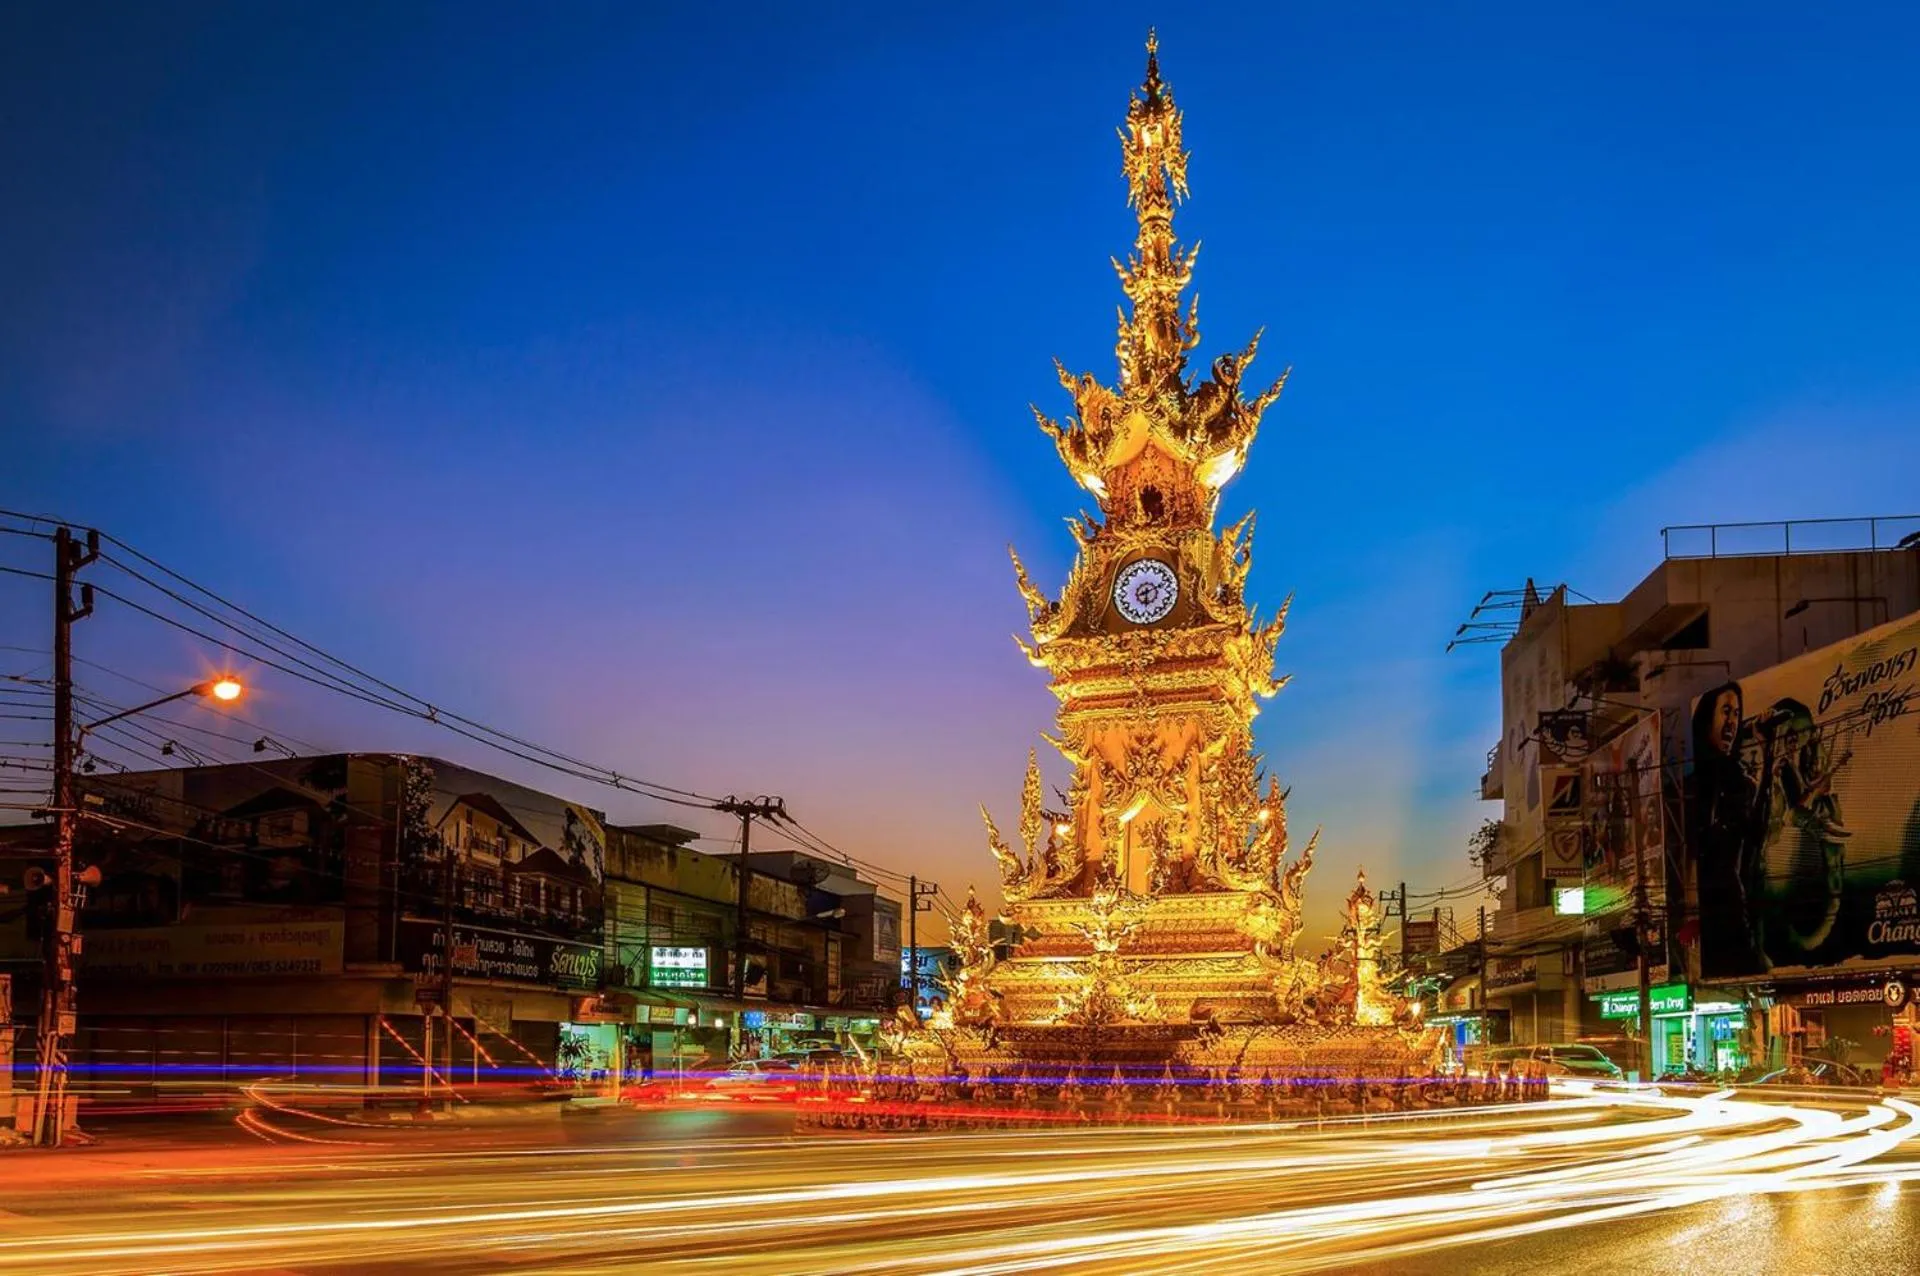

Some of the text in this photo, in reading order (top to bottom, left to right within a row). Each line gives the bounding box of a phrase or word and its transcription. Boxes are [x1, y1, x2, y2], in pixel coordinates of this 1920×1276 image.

[1819, 647, 1918, 715] ชีวิตของเรา
[1666, 996, 1689, 1011] Drug
[1806, 988, 1883, 1005] กาแฟ ยอดดอย
